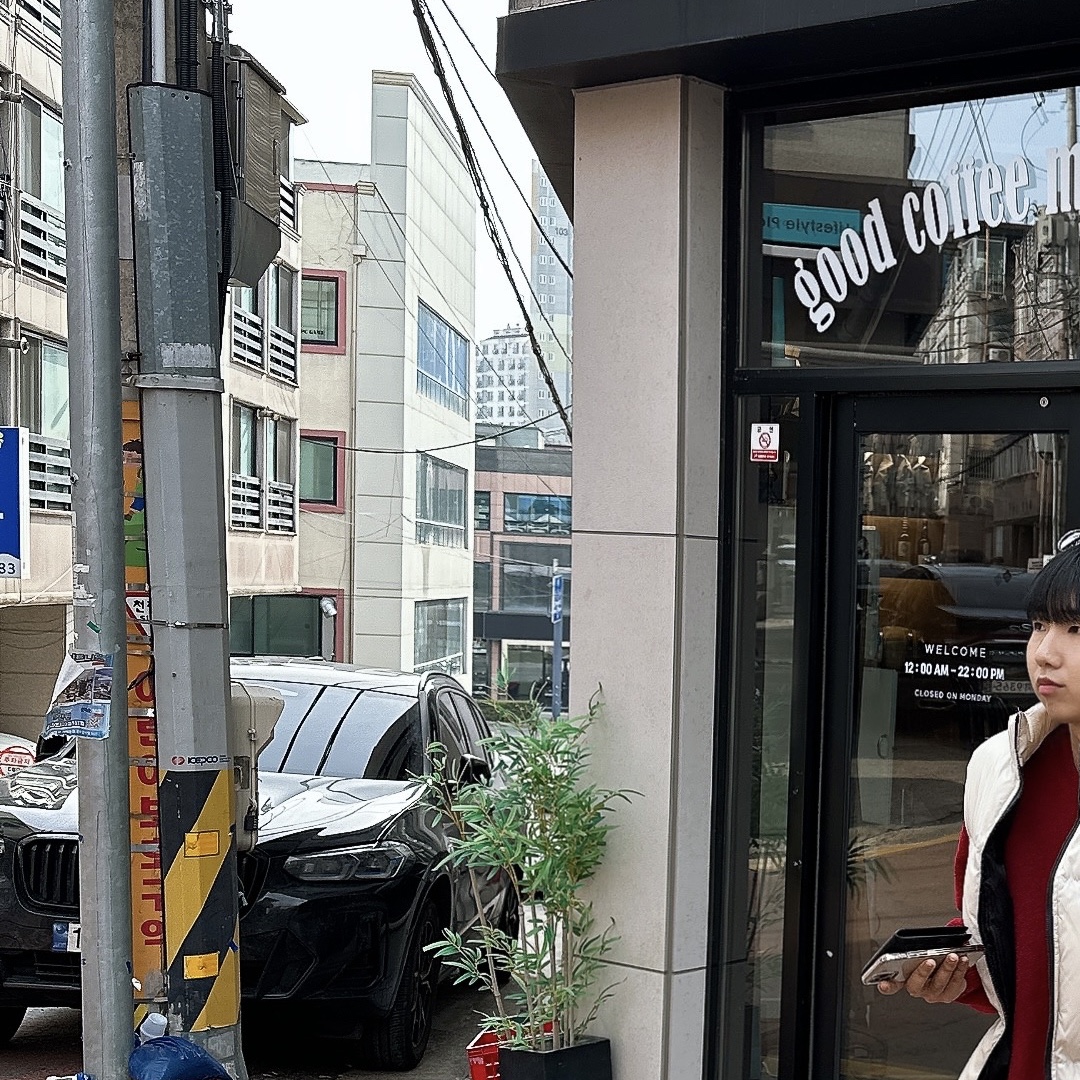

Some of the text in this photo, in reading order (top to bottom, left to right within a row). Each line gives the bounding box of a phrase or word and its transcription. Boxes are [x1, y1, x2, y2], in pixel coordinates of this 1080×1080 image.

[794, 198, 898, 333] good
[902, 154, 1031, 254] coffee
[924, 643, 986, 658] WELCOME
[904, 661, 932, 675] 12:00
[933, 664, 949, 676] AM
[958, 665, 989, 679] 22:00
[990, 668, 1005, 680] PM
[914, 689, 992, 703] CLOSED ON MONDAY
